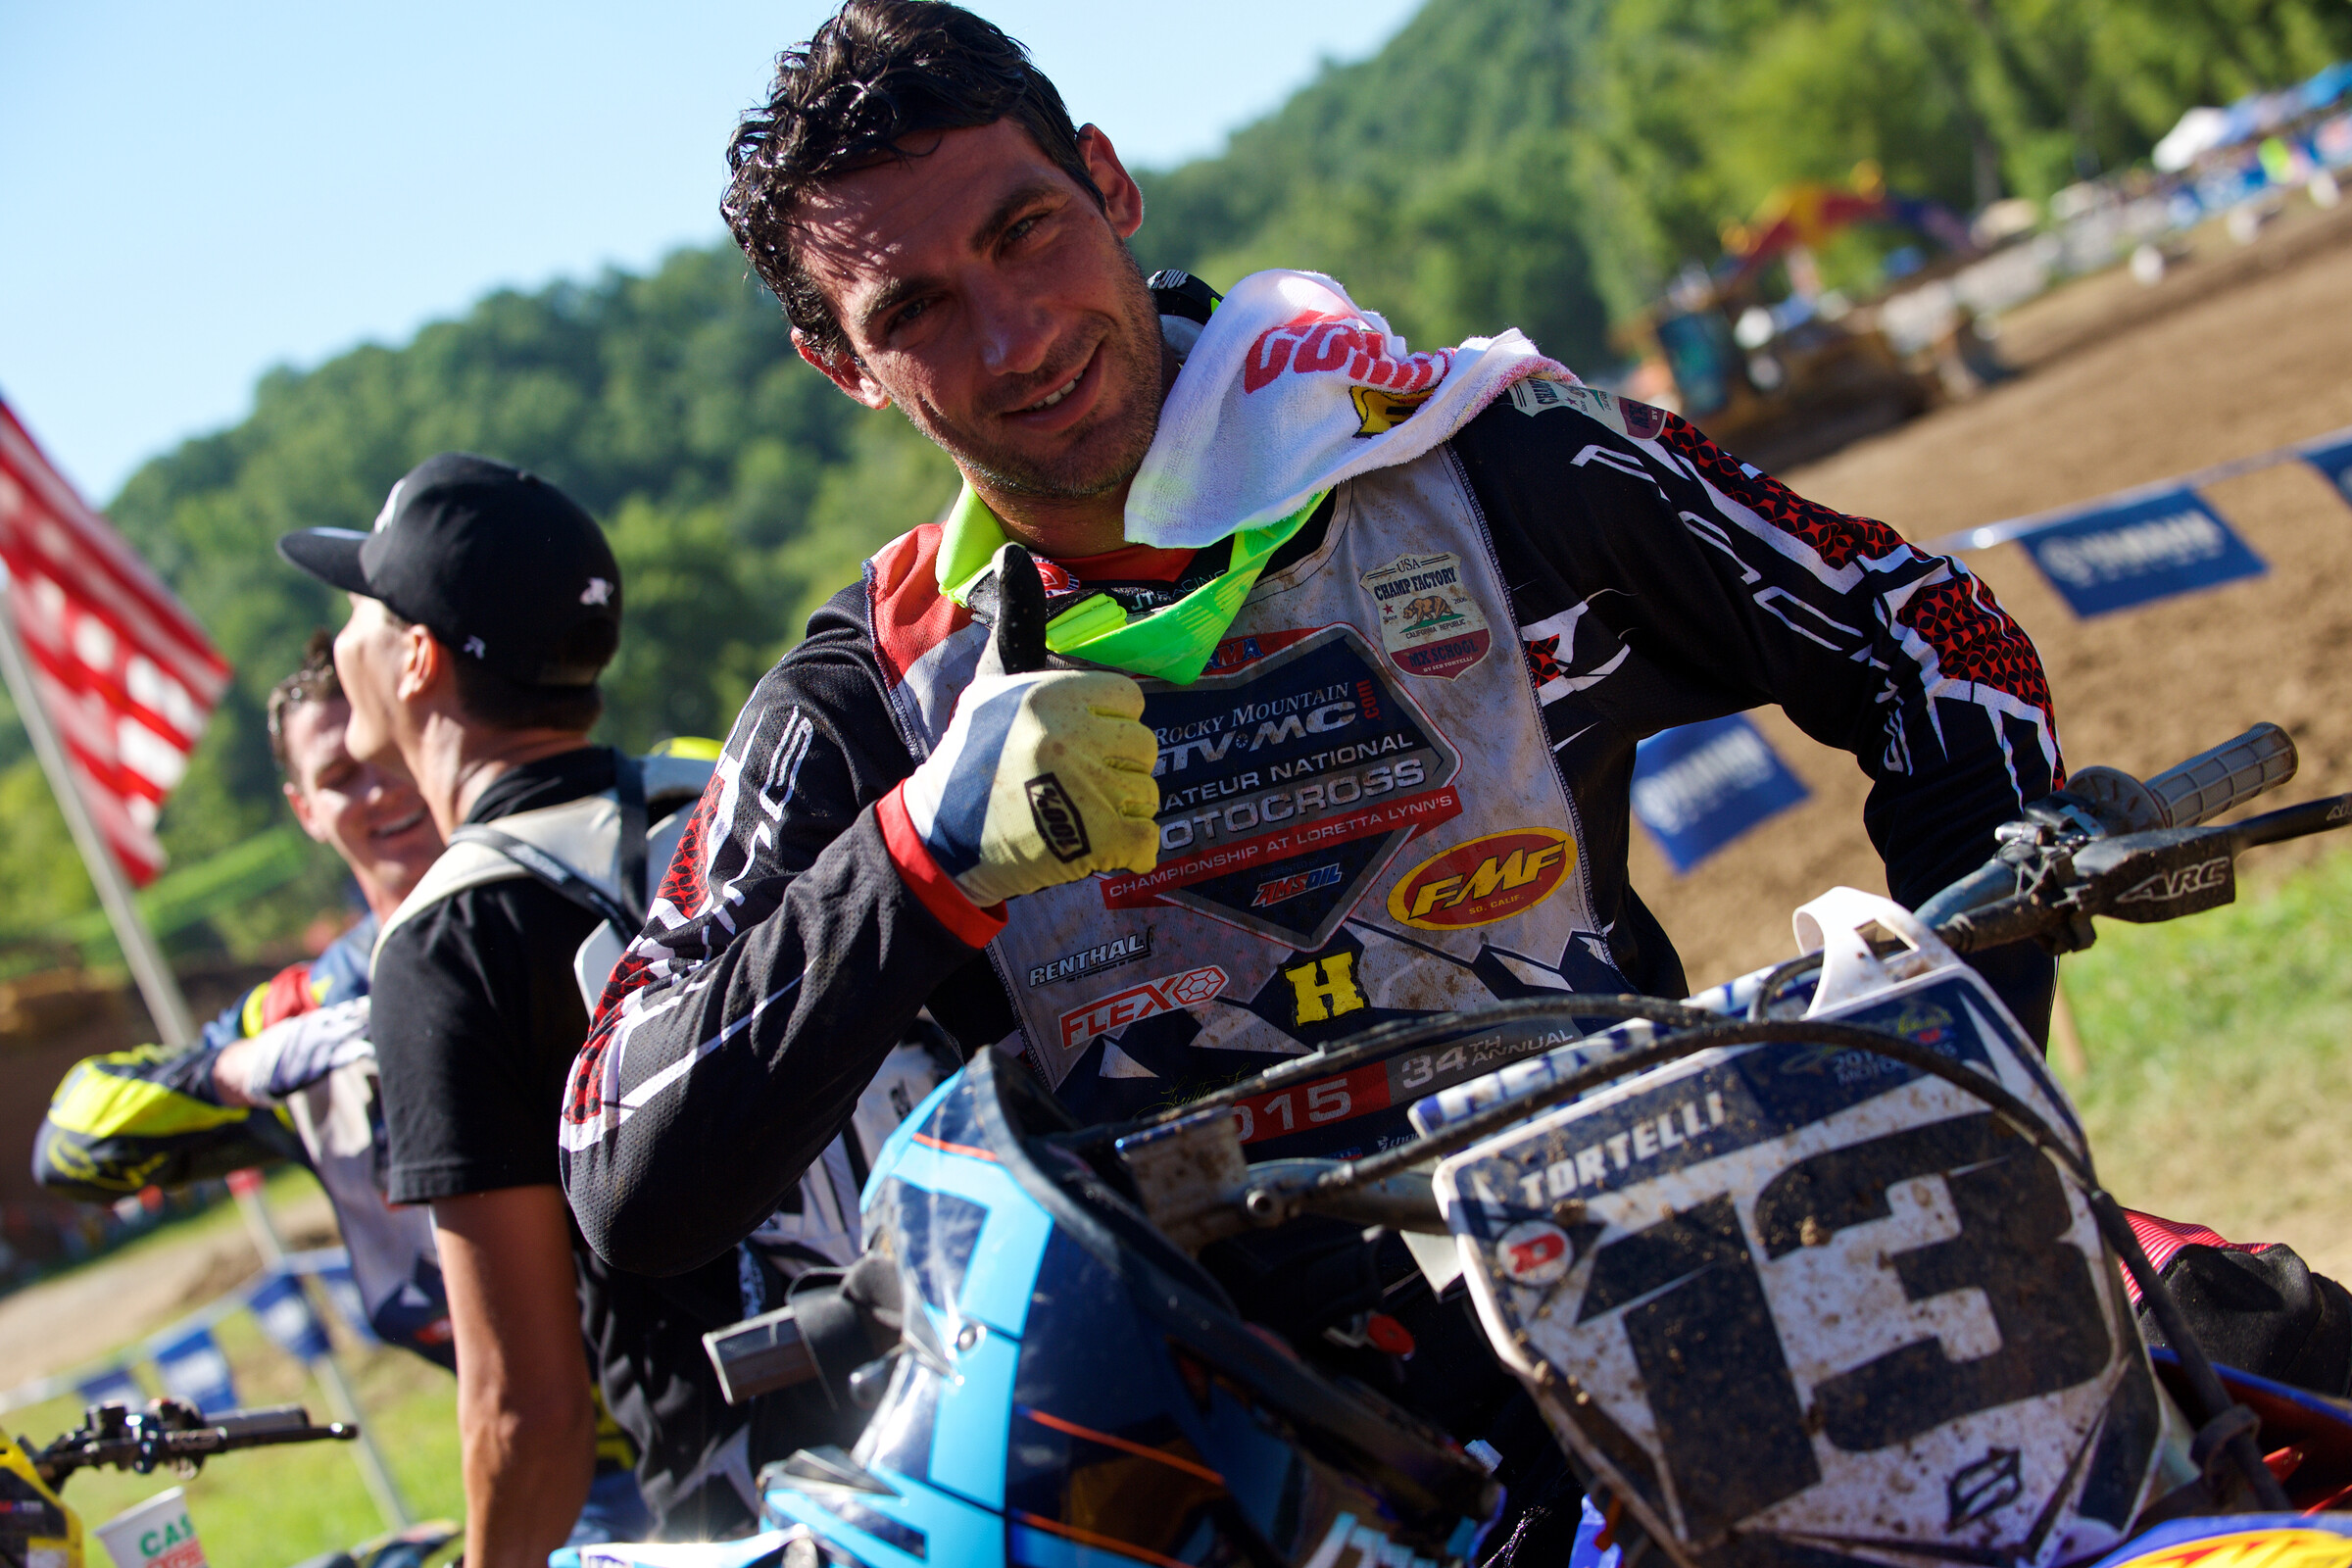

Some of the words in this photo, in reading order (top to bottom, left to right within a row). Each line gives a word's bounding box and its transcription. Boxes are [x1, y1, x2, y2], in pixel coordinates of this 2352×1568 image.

[1374, 578, 1411, 601] CHAMP
[1411, 566, 1457, 592] FACTORY
[1396, 558, 1421, 573] USA
[1131, 591, 1156, 612] JT
[1405, 626, 1438, 640] CALIFORNIA
[1440, 618, 1466, 631] REPUBLIC
[1408, 649, 1432, 667] MX
[1433, 638, 1479, 663] SCHOOL
[1153, 715, 1225, 746] ROCKY
[1232, 681, 1350, 728] MOUNTAIN
[1157, 771, 1260, 812] ATEUR
[1269, 733, 1414, 782] NATIONAL
[1157, 758, 1427, 854] OTOCROSS
[1109, 845, 1259, 899] CHAMPIONSHIP
[1265, 837, 1291, 854] AT
[1296, 812, 1383, 845] LORETTA
[1388, 794, 1453, 822] LYNN'S
[1250, 862, 1344, 907] AMSOIL
[1407, 840, 1567, 921] FMF
[1490, 895, 1525, 909] CALIF.
[2115, 855, 2230, 904] ARC
[1029, 933, 1147, 988] RENTHAL
[1285, 950, 1369, 1028] H
[1401, 1044, 1469, 1091] 34
[1469, 1034, 1502, 1054] TH
[1471, 1028, 1574, 1067] ANNUAL
[1231, 1077, 1353, 1144] 015
[1519, 1089, 1726, 1210] TORTELLI
[1573, 1108, 2112, 1546] 13
